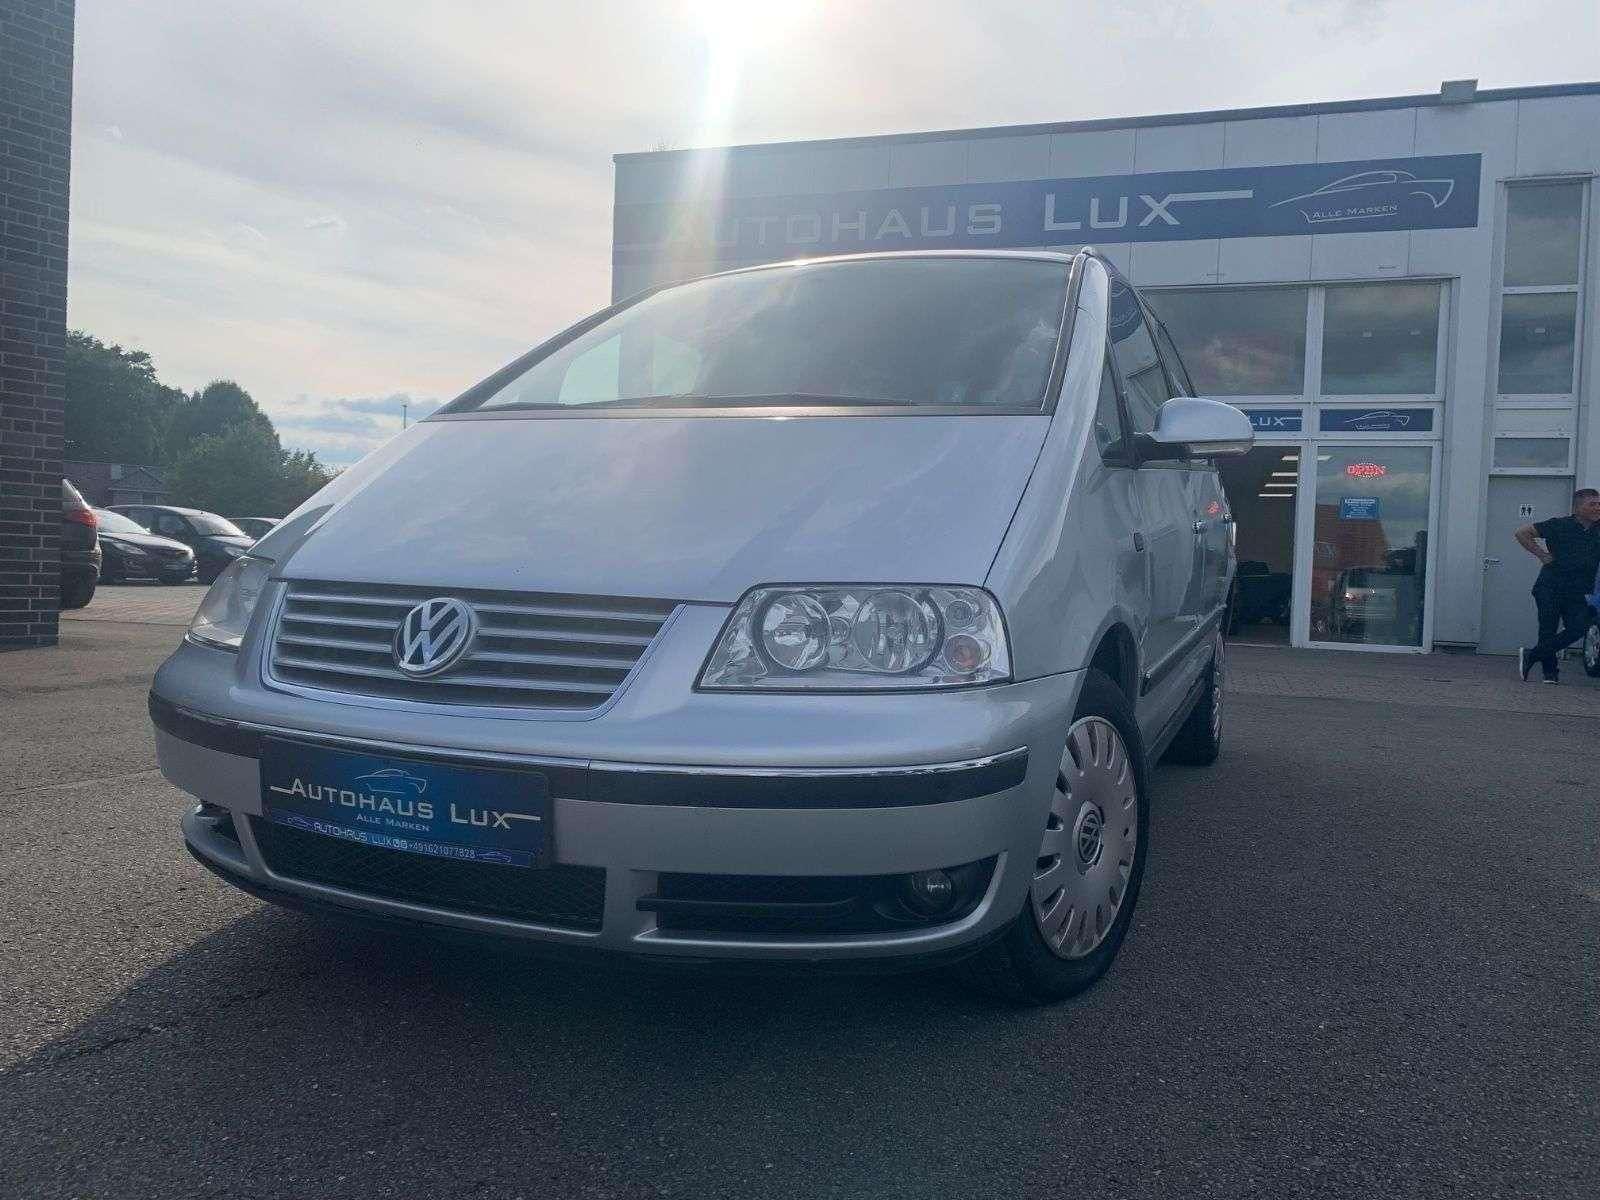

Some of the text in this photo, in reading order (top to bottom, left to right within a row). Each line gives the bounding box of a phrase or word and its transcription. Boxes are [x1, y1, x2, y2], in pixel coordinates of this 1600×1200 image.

[1042, 192, 1186, 231] LUX
[1312, 204, 1399, 219] ALLE MARKEN
[287, 777, 515, 830] AUTOHAUS LUX
[356, 813, 430, 832] ALLE MARKEN
